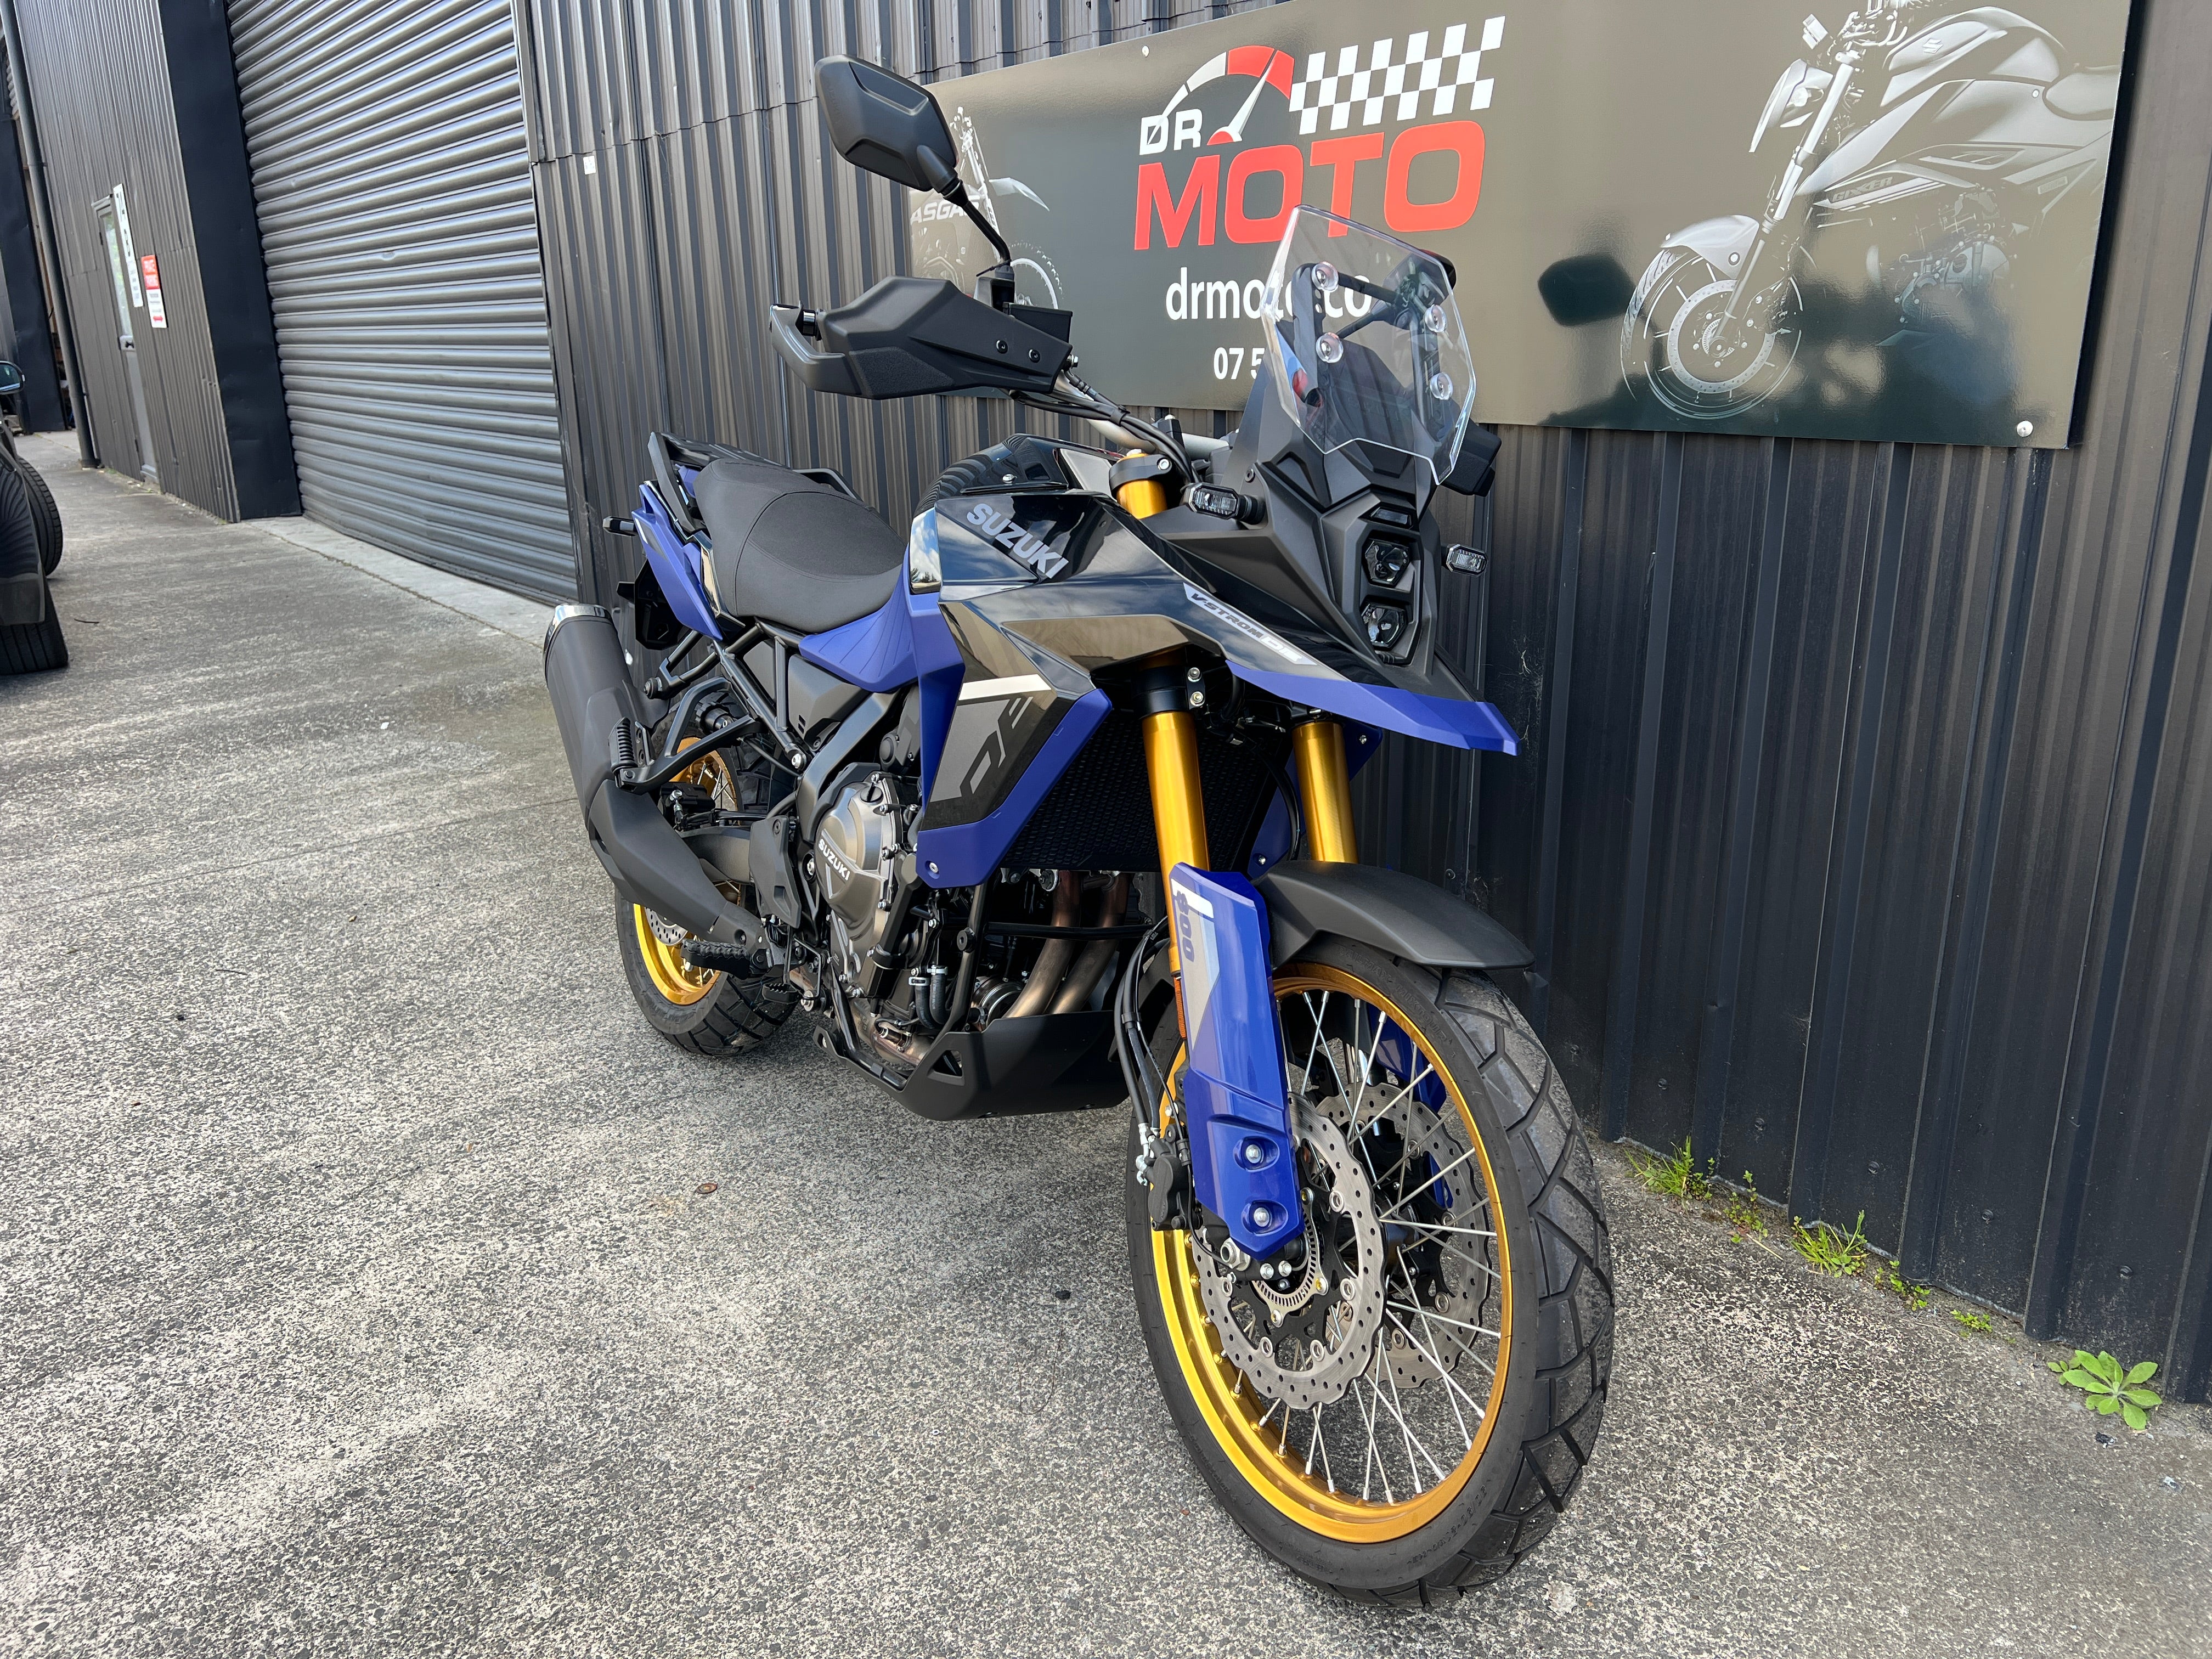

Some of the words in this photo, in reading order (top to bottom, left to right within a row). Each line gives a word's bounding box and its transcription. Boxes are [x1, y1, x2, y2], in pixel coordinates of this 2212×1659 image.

[1139, 109, 1203, 155] DR
[1134, 120, 1486, 251] MOTO
[1166, 267, 1372, 320] drmoco
[1214, 347, 1244, 380] 07
[967, 503, 1069, 579] SUZUKI
[1191, 593, 1264, 639] V-STROM
[819, 838, 850, 881] SUZUKI
[1176, 890, 1195, 963] 800
